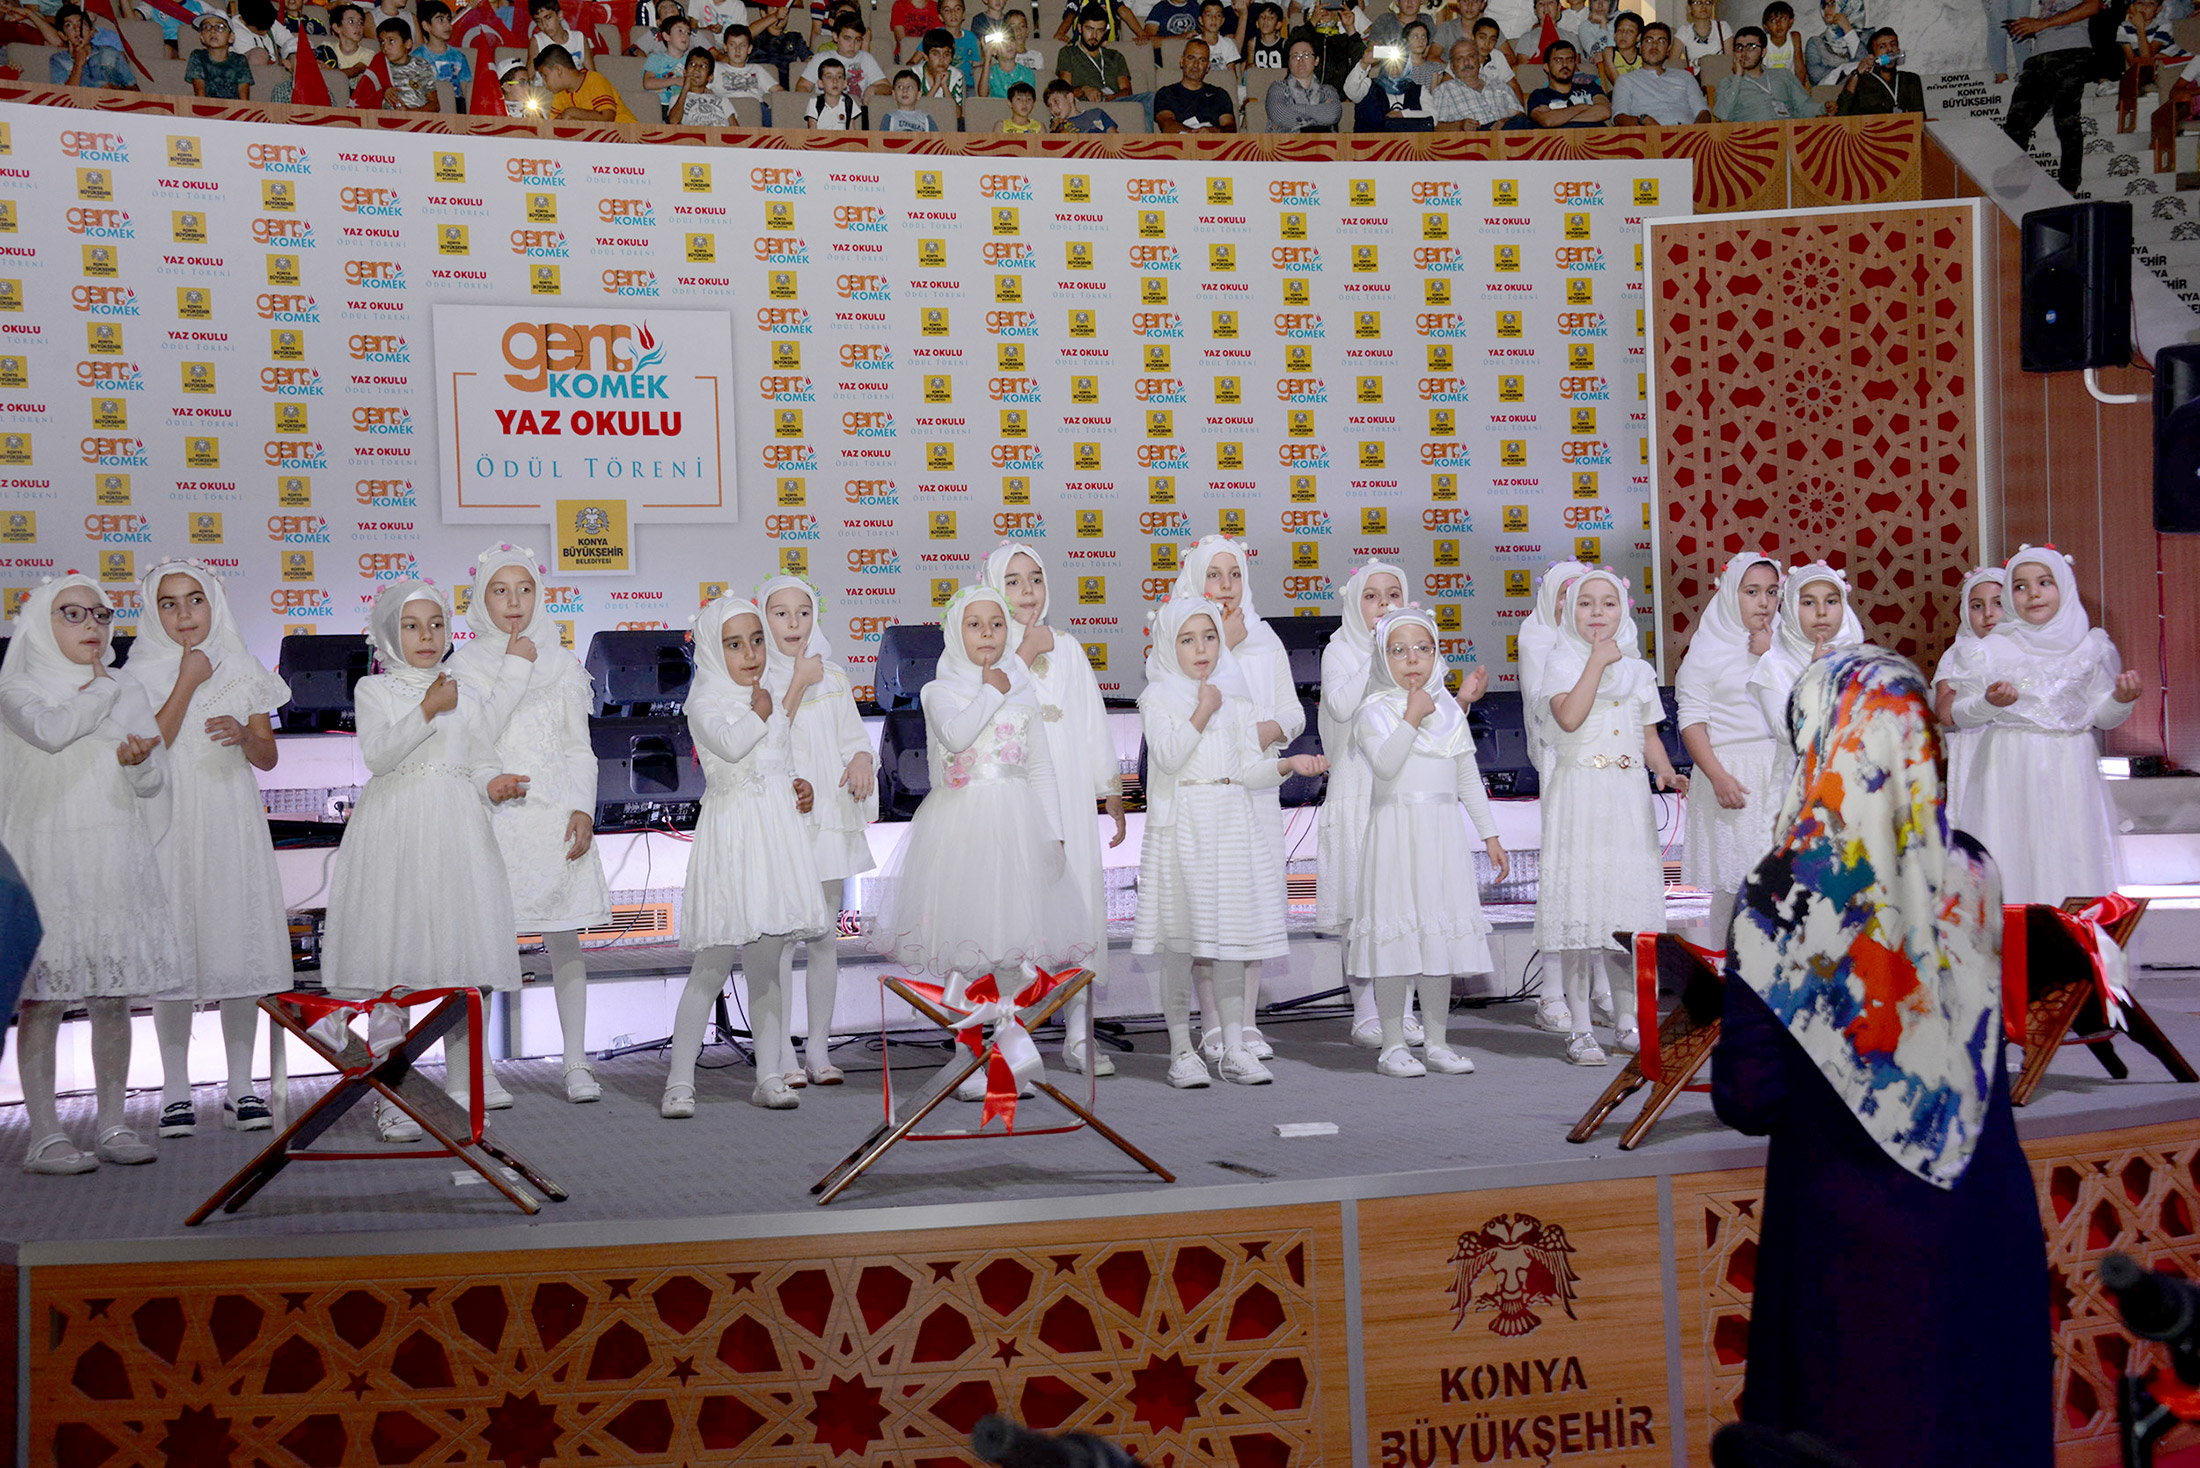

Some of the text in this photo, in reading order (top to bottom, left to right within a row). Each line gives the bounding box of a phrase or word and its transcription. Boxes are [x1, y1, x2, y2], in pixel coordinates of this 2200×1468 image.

[1941, 74, 1970, 82] KONYA
[1957, 88, 1987, 97] KONYA
[1942, 95, 2002, 108] BÜYÜKŞEHİR
[1970, 108, 2000, 117] KONYA
[80, 150, 130, 164] KOMEK
[339, 153, 395, 164] YAZ OKULU
[264, 162, 312, 176] KOMEK
[593, 166, 645, 175] YAZ OKULU
[523, 176, 566, 187] KOMEK
[830, 174, 879, 183] YAZ OKULU
[158, 179, 218, 190] YAZ OKULU
[995, 191, 1034, 201] KOMEK
[1567, 196, 1604, 206] KOMEK
[1425, 196, 1462, 208] KOMEK
[358, 205, 404, 216] KOMEK
[675, 206, 726, 215] YAZ OKULU
[1074, 214, 1103, 222] OKULU
[86, 226, 136, 240] KOMEK
[163, 256, 223, 266] YAZ OKULU
[770, 254, 810, 264] KOMEK
[1427, 263, 1464, 272] KOMEK
[1202, 283, 1248, 291] YAZ OKULU
[91, 304, 140, 316] KOMEK
[274, 311, 320, 323] KOMEK
[168, 331, 228, 341] YAZ OKULU
[1000, 327, 1039, 336] KOMEK
[1147, 329, 1184, 338] KOMEK
[1430, 329, 1467, 338] KOMEK
[502, 322, 633, 393] genç
[1507, 349, 1535, 358] OKULU
[95, 380, 144, 392] KOMEK
[550, 373, 670, 399] KOMEK
[838, 382, 856, 390] YAZ
[1291, 394, 1328, 406] KOMEK
[1573, 392, 1610, 401] KOMEK
[172, 408, 231, 417] YAZ OKULU
[494, 409, 682, 437] YAZ OKULU
[1349, 416, 1365, 424] YAZ
[857, 428, 896, 440] KOMEK
[280, 459, 328, 472] KOMEK
[476, 453, 703, 478] ÖDÜL TÖRENİ
[1292, 458, 1331, 471] KOMEK
[1066, 482, 1114, 490] YAZ OKULU
[1510, 478, 1538, 486] OKULU
[357, 522, 413, 530] YAZ OKULU
[1295, 526, 1332, 536] KOMEK
[1576, 520, 1615, 533] KOMEK
[102, 532, 152, 544] KOMEK
[578, 538, 608, 547] KONYA
[562, 546, 624, 559] BÜYÜKŞEHİR
[940, 553, 970, 561] OKULU
[1297, 592, 1336, 601] KOMEK
[286, 606, 336, 619] KOMEK
[1440, 1356, 1588, 1404] KONYA
[1381, 1397, 1657, 1468] BÜYÜKŞEHİR
